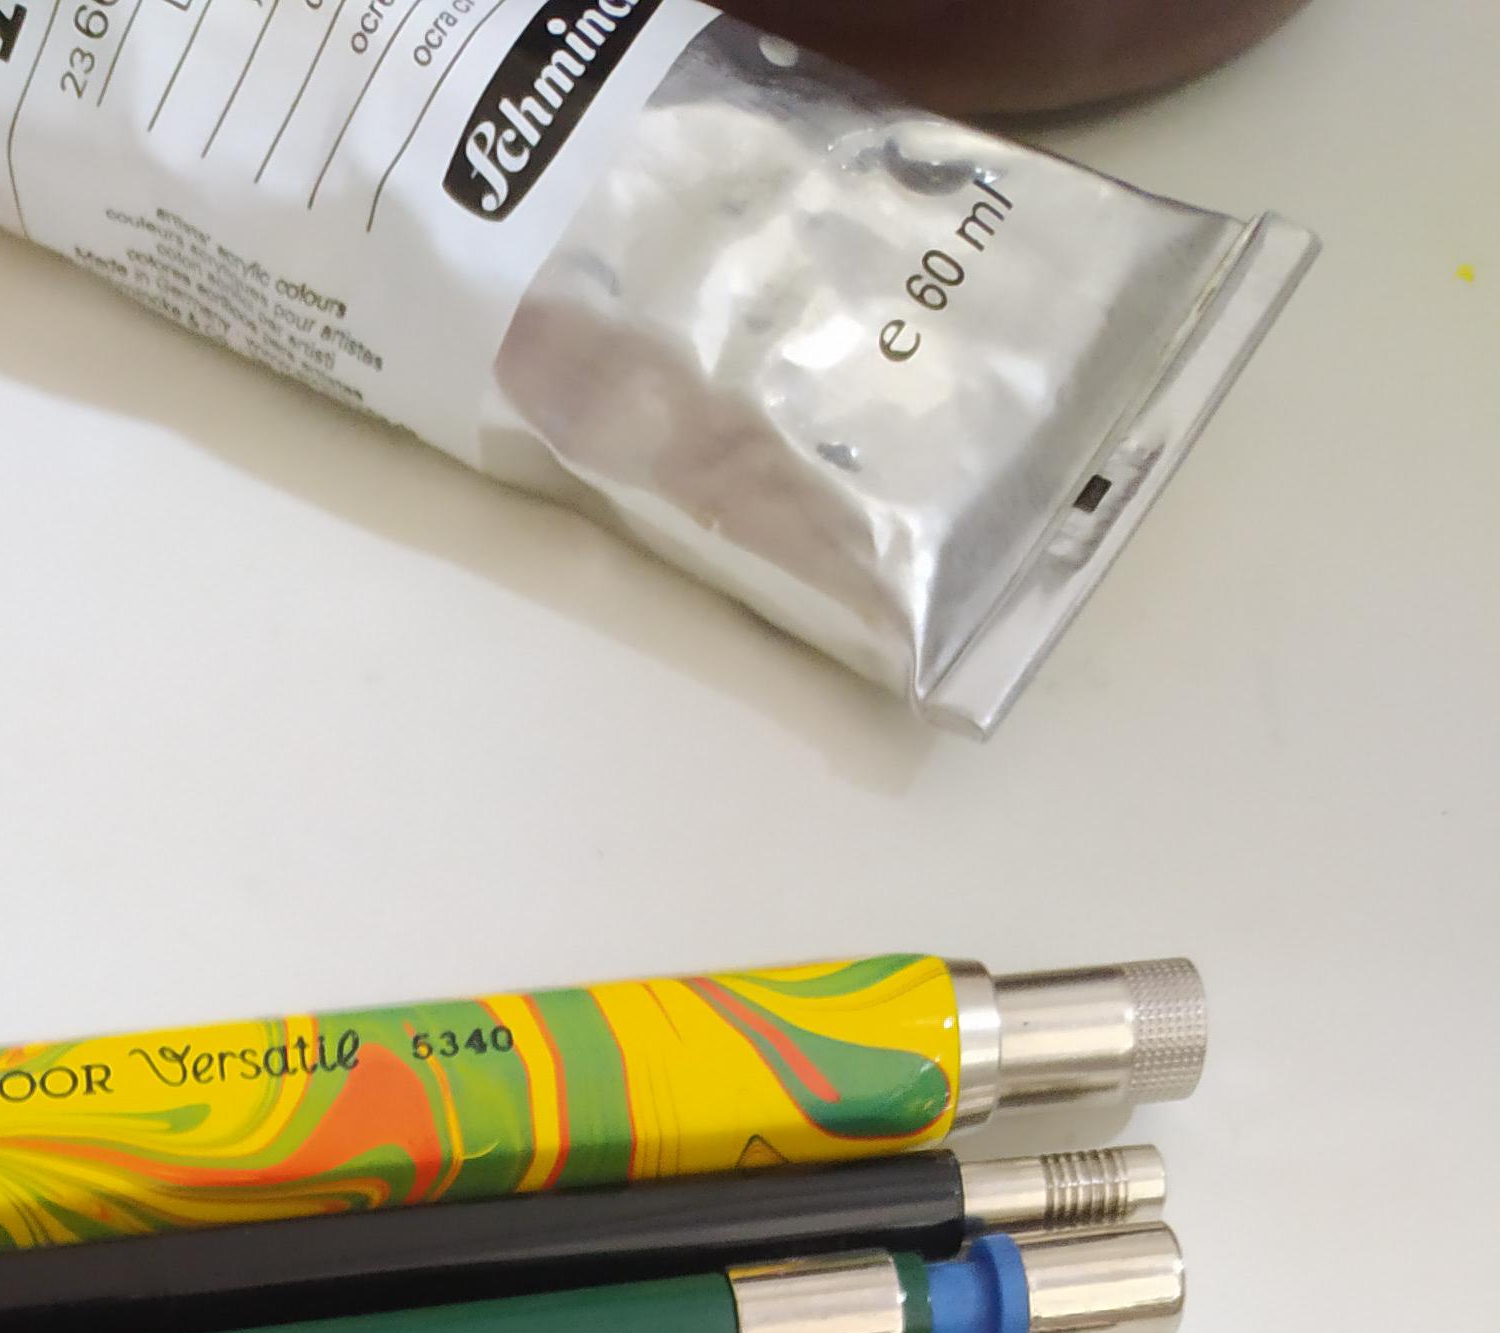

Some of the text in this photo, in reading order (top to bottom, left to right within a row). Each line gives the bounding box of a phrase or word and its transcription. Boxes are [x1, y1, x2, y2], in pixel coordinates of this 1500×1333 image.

[413, 10, 459, 67] ocra
[60, 47, 96, 100] 23
[905, 249, 967, 312] 60
[955, 178, 1015, 253] ml
[273, 302, 317, 332] pour
[274, 276, 348, 319] colours
[411, 1025, 515, 1061] 5340
